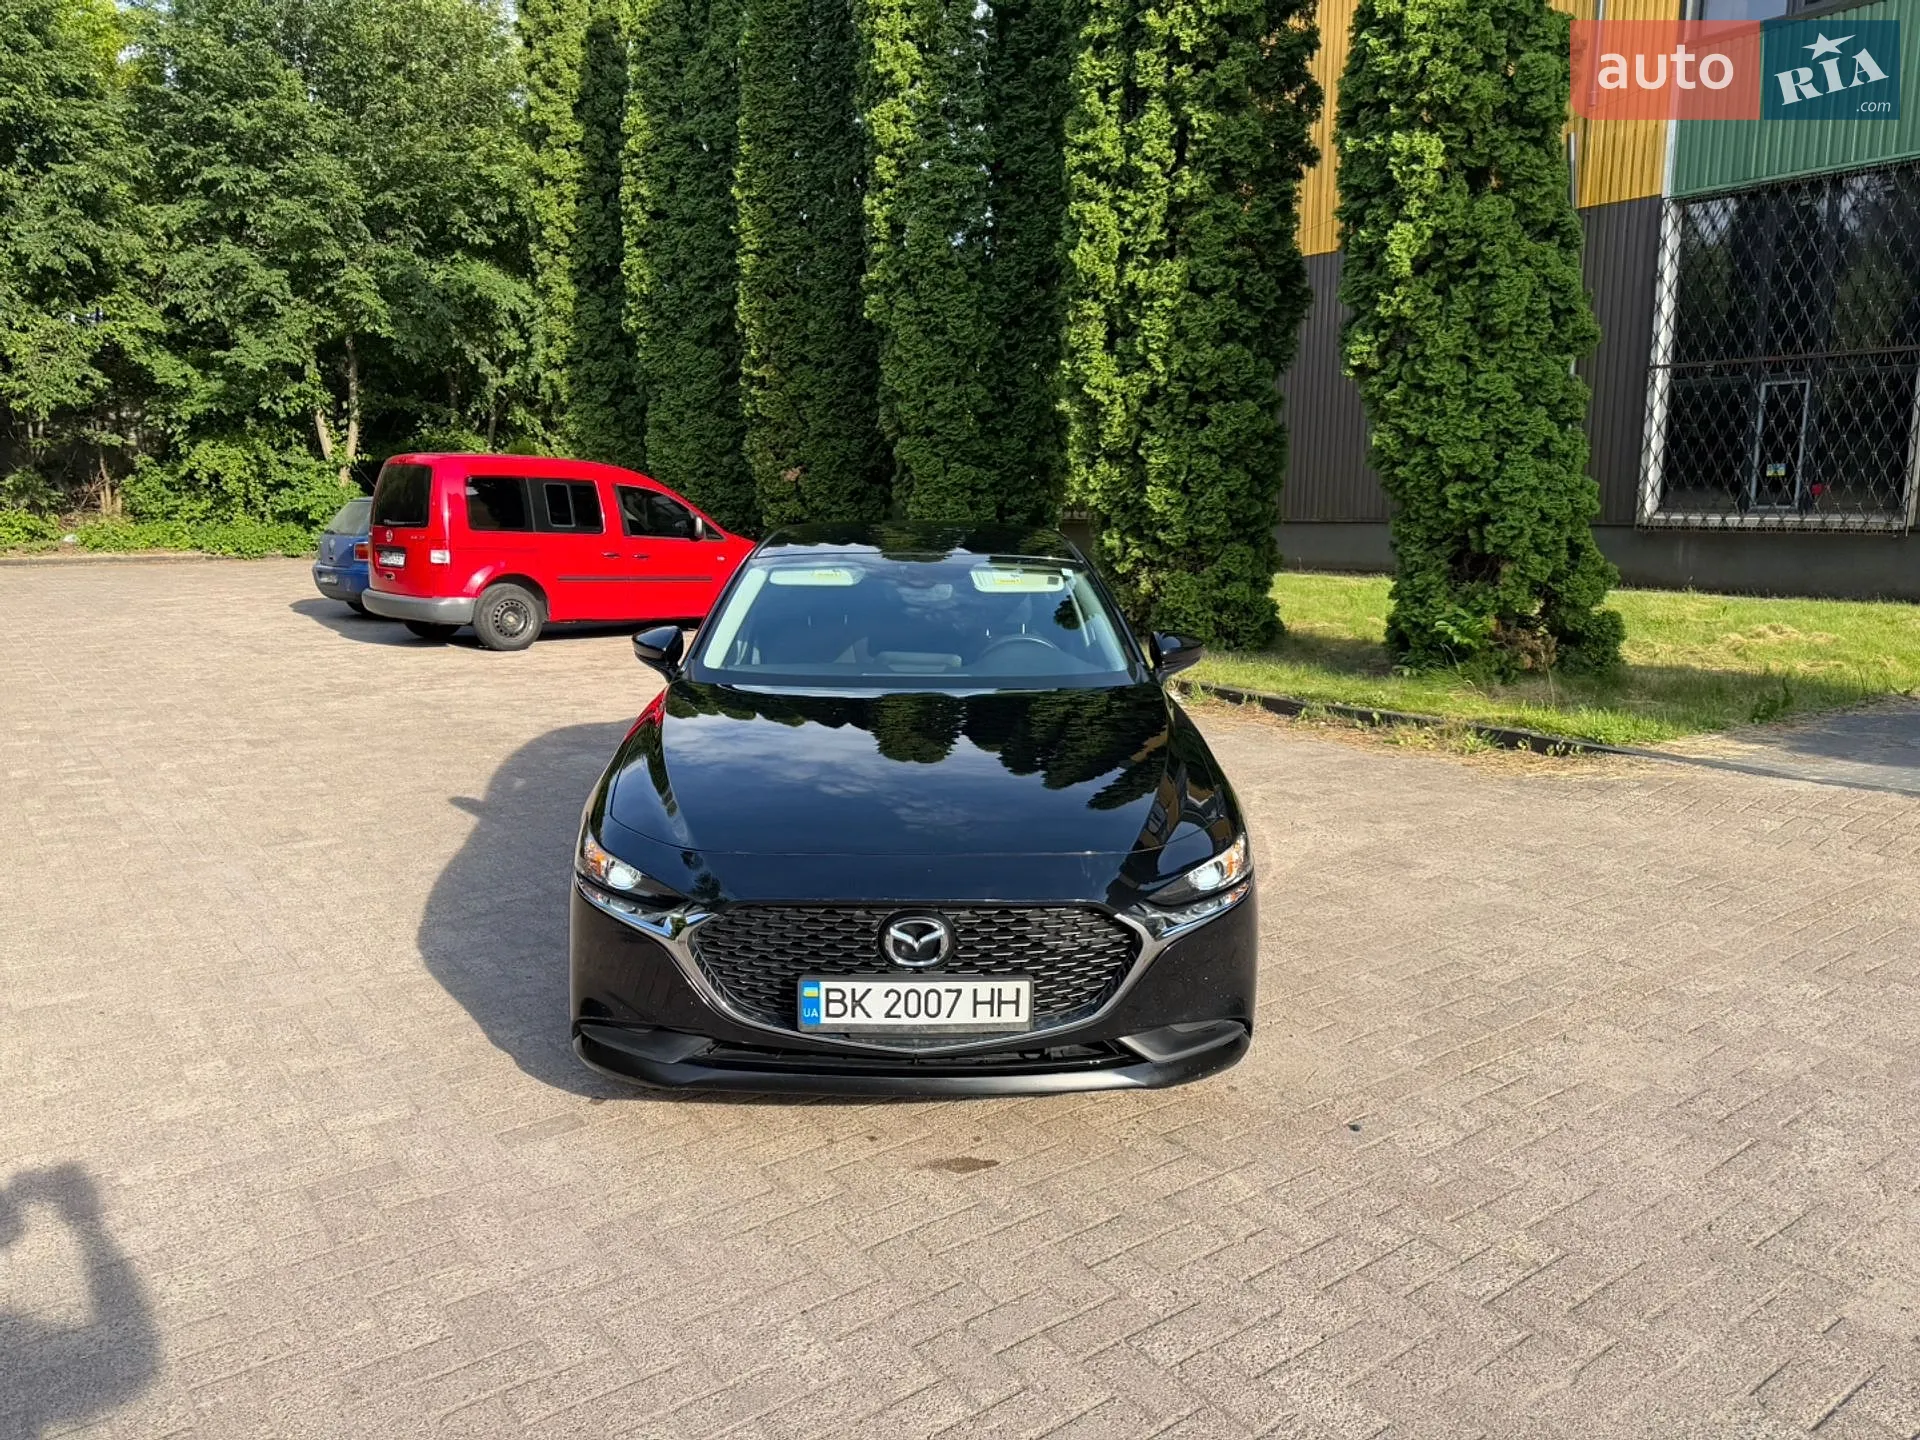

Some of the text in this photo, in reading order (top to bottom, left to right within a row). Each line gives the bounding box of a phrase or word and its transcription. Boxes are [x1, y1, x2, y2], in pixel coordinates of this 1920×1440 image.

[803, 1008, 819, 1017] UA
[825, 987, 1021, 1018] BK 2007 HH
